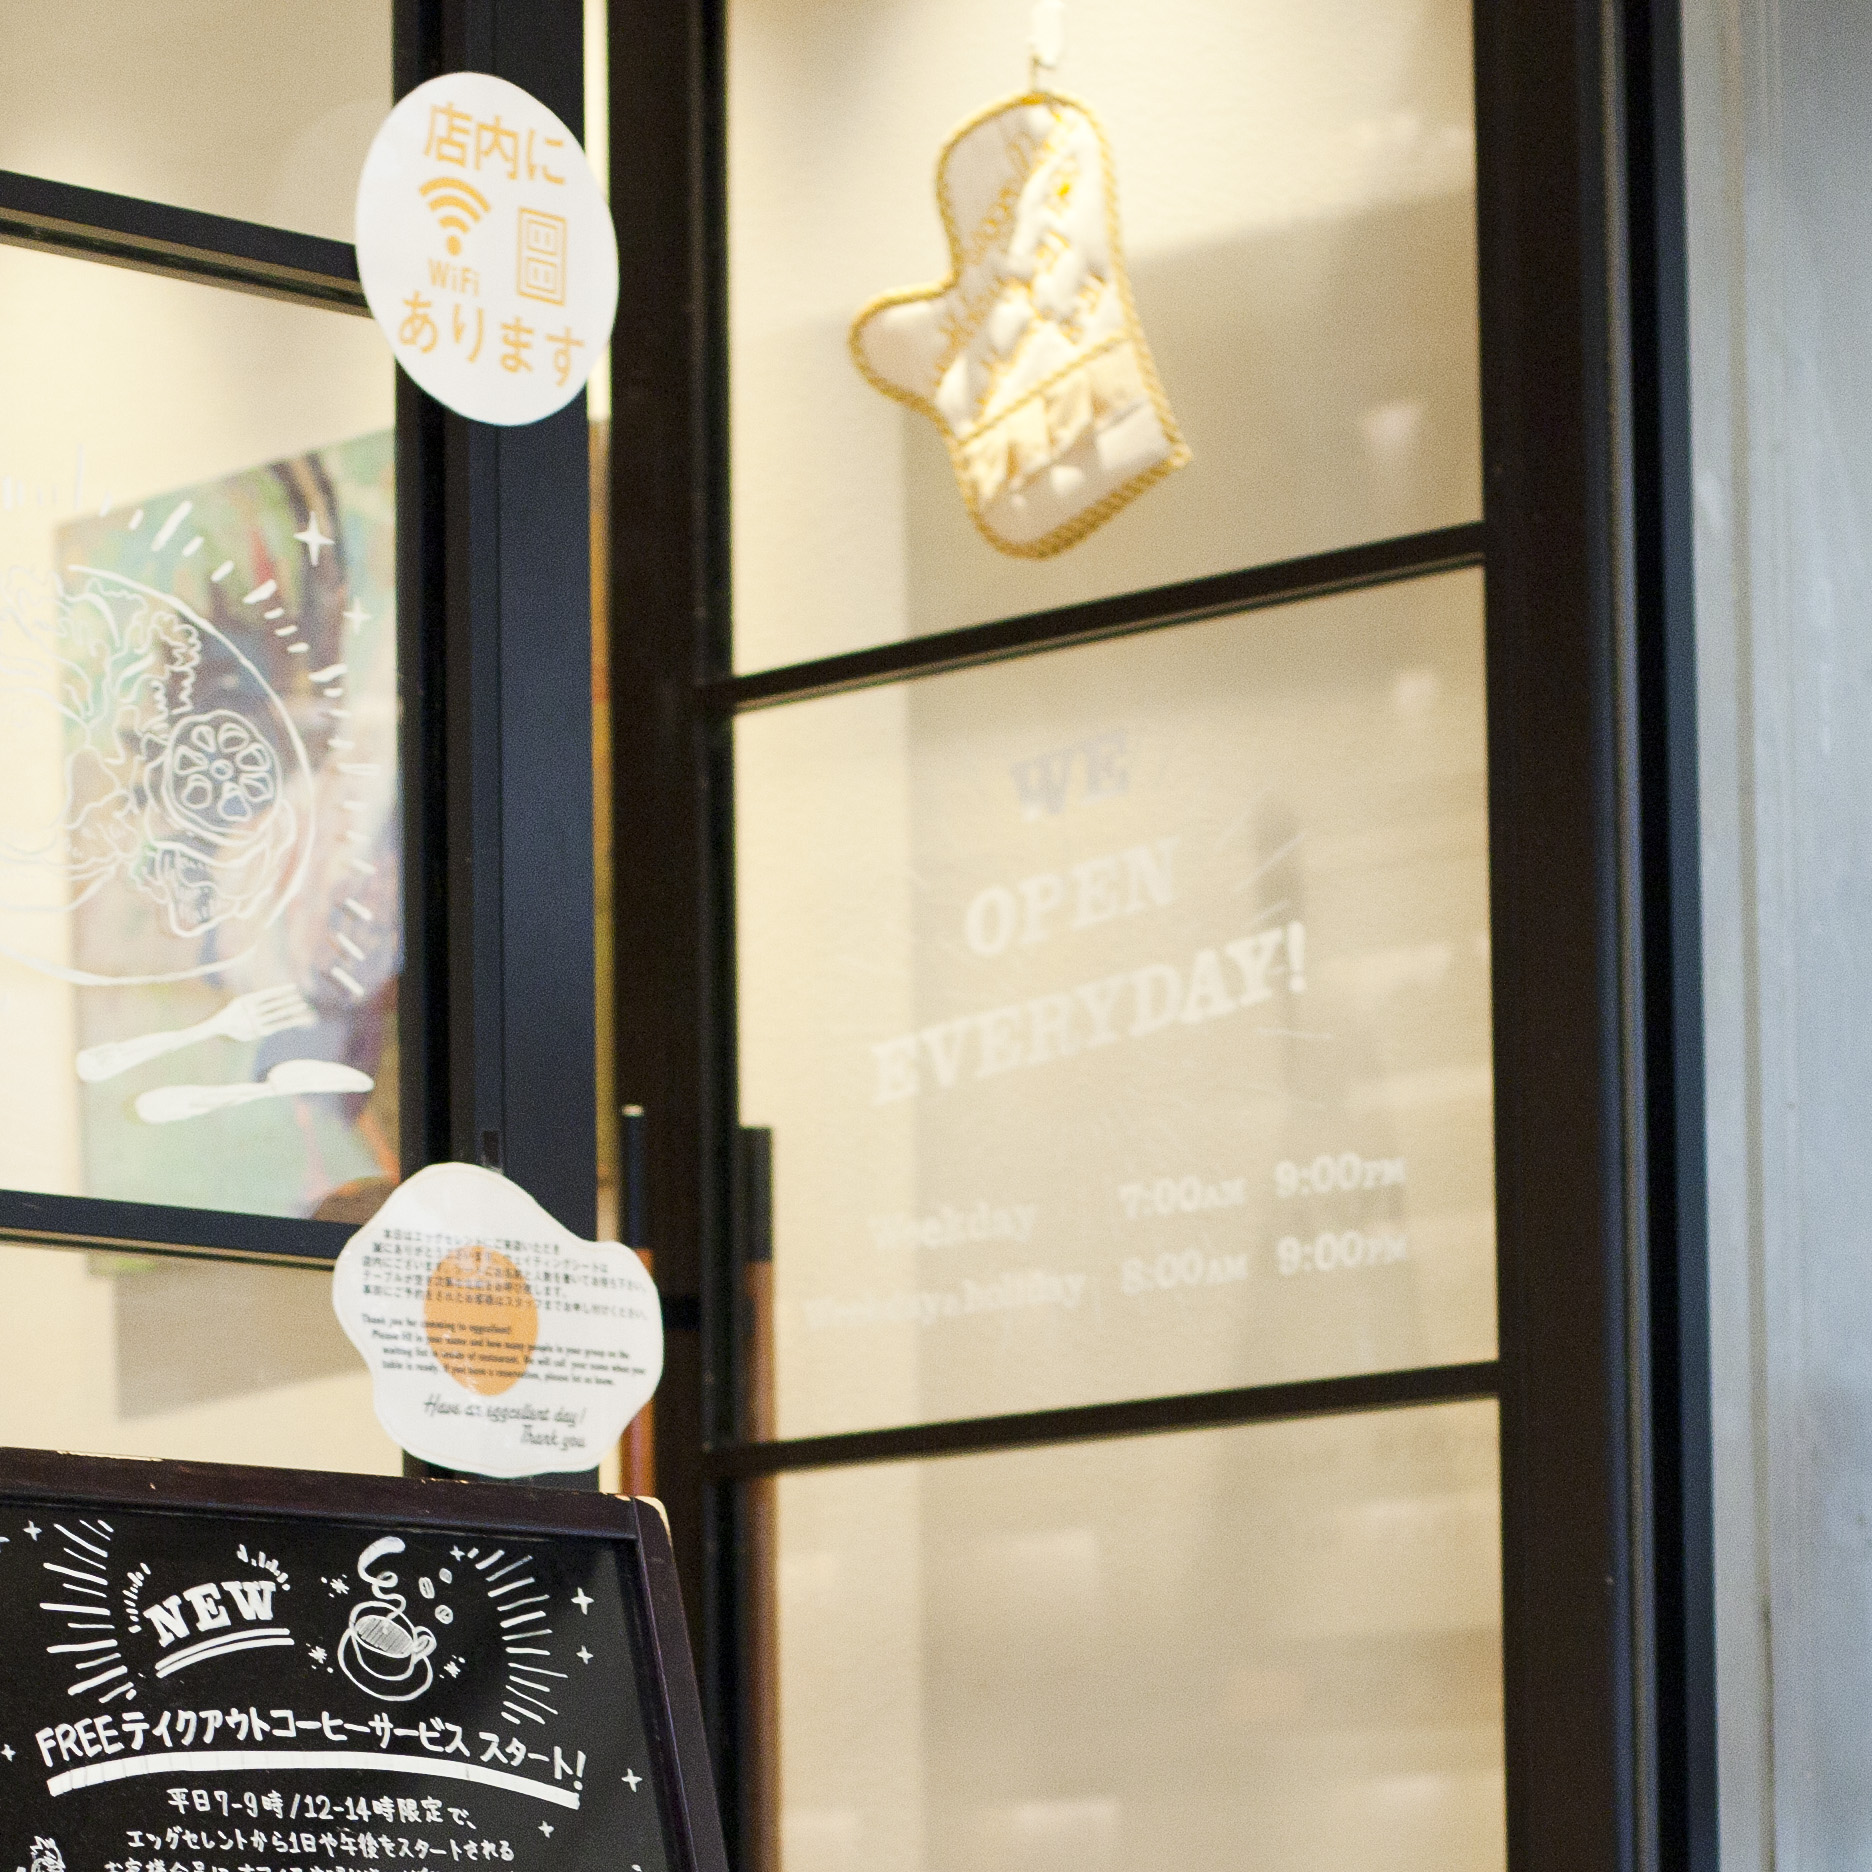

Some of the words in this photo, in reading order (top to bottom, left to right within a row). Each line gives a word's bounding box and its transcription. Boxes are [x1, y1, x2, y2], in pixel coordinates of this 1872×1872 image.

[424, 101, 567, 186] 店内に
[428, 258, 481, 297] WiFi
[398, 290, 586, 388] あります
[964, 834, 1181, 958] OPEN
[869, 920, 1307, 1106] EVERYDAY!
[1274, 1151, 1409, 1199] 9:00PM
[1120, 1248, 1250, 1296] 8:00AM
[1274, 1230, 1409, 1277] 9:00PM
[424, 1393, 461, 1417] Have
[520, 1423, 559, 1446] Thank
[142, 1580, 279, 1649] NEW
